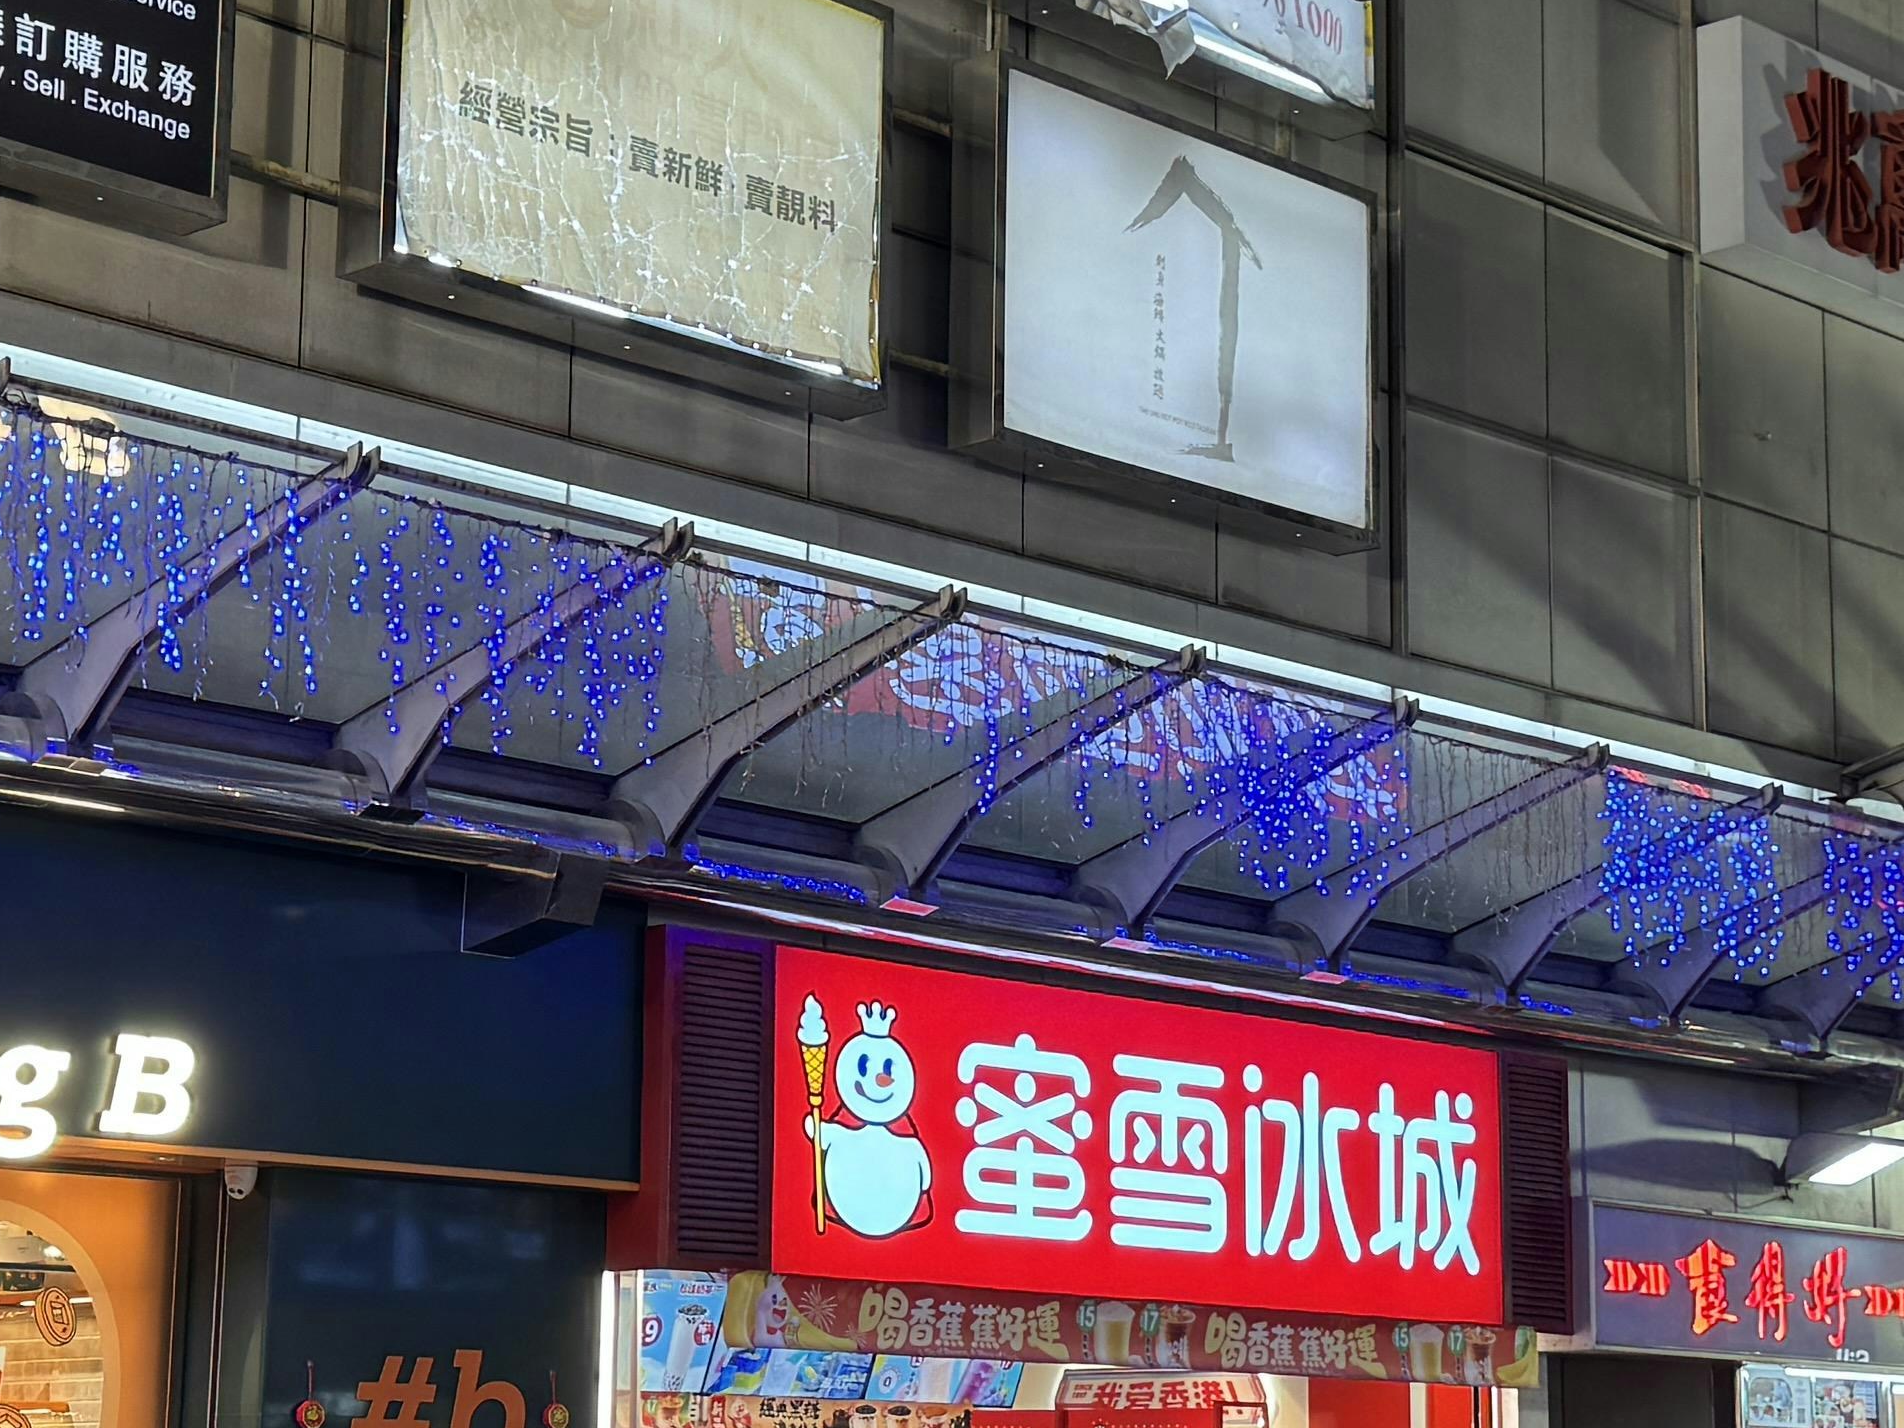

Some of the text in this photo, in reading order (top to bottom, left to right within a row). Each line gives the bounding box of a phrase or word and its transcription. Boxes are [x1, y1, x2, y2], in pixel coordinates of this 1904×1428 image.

[22, 70, 67, 104] Sell
[83, 87, 192, 142] Exchange
[743, 173, 840, 234] 賣靚料
[97, 1031, 198, 1139] B
[954, 1032, 1482, 1277] 蜜雪冰城
[1078, 1305, 1095, 1329] 15
[1143, 1310, 1160, 1331] 17
[1395, 1327, 1409, 1348] 15
[1449, 1332, 1463, 1350] 17
